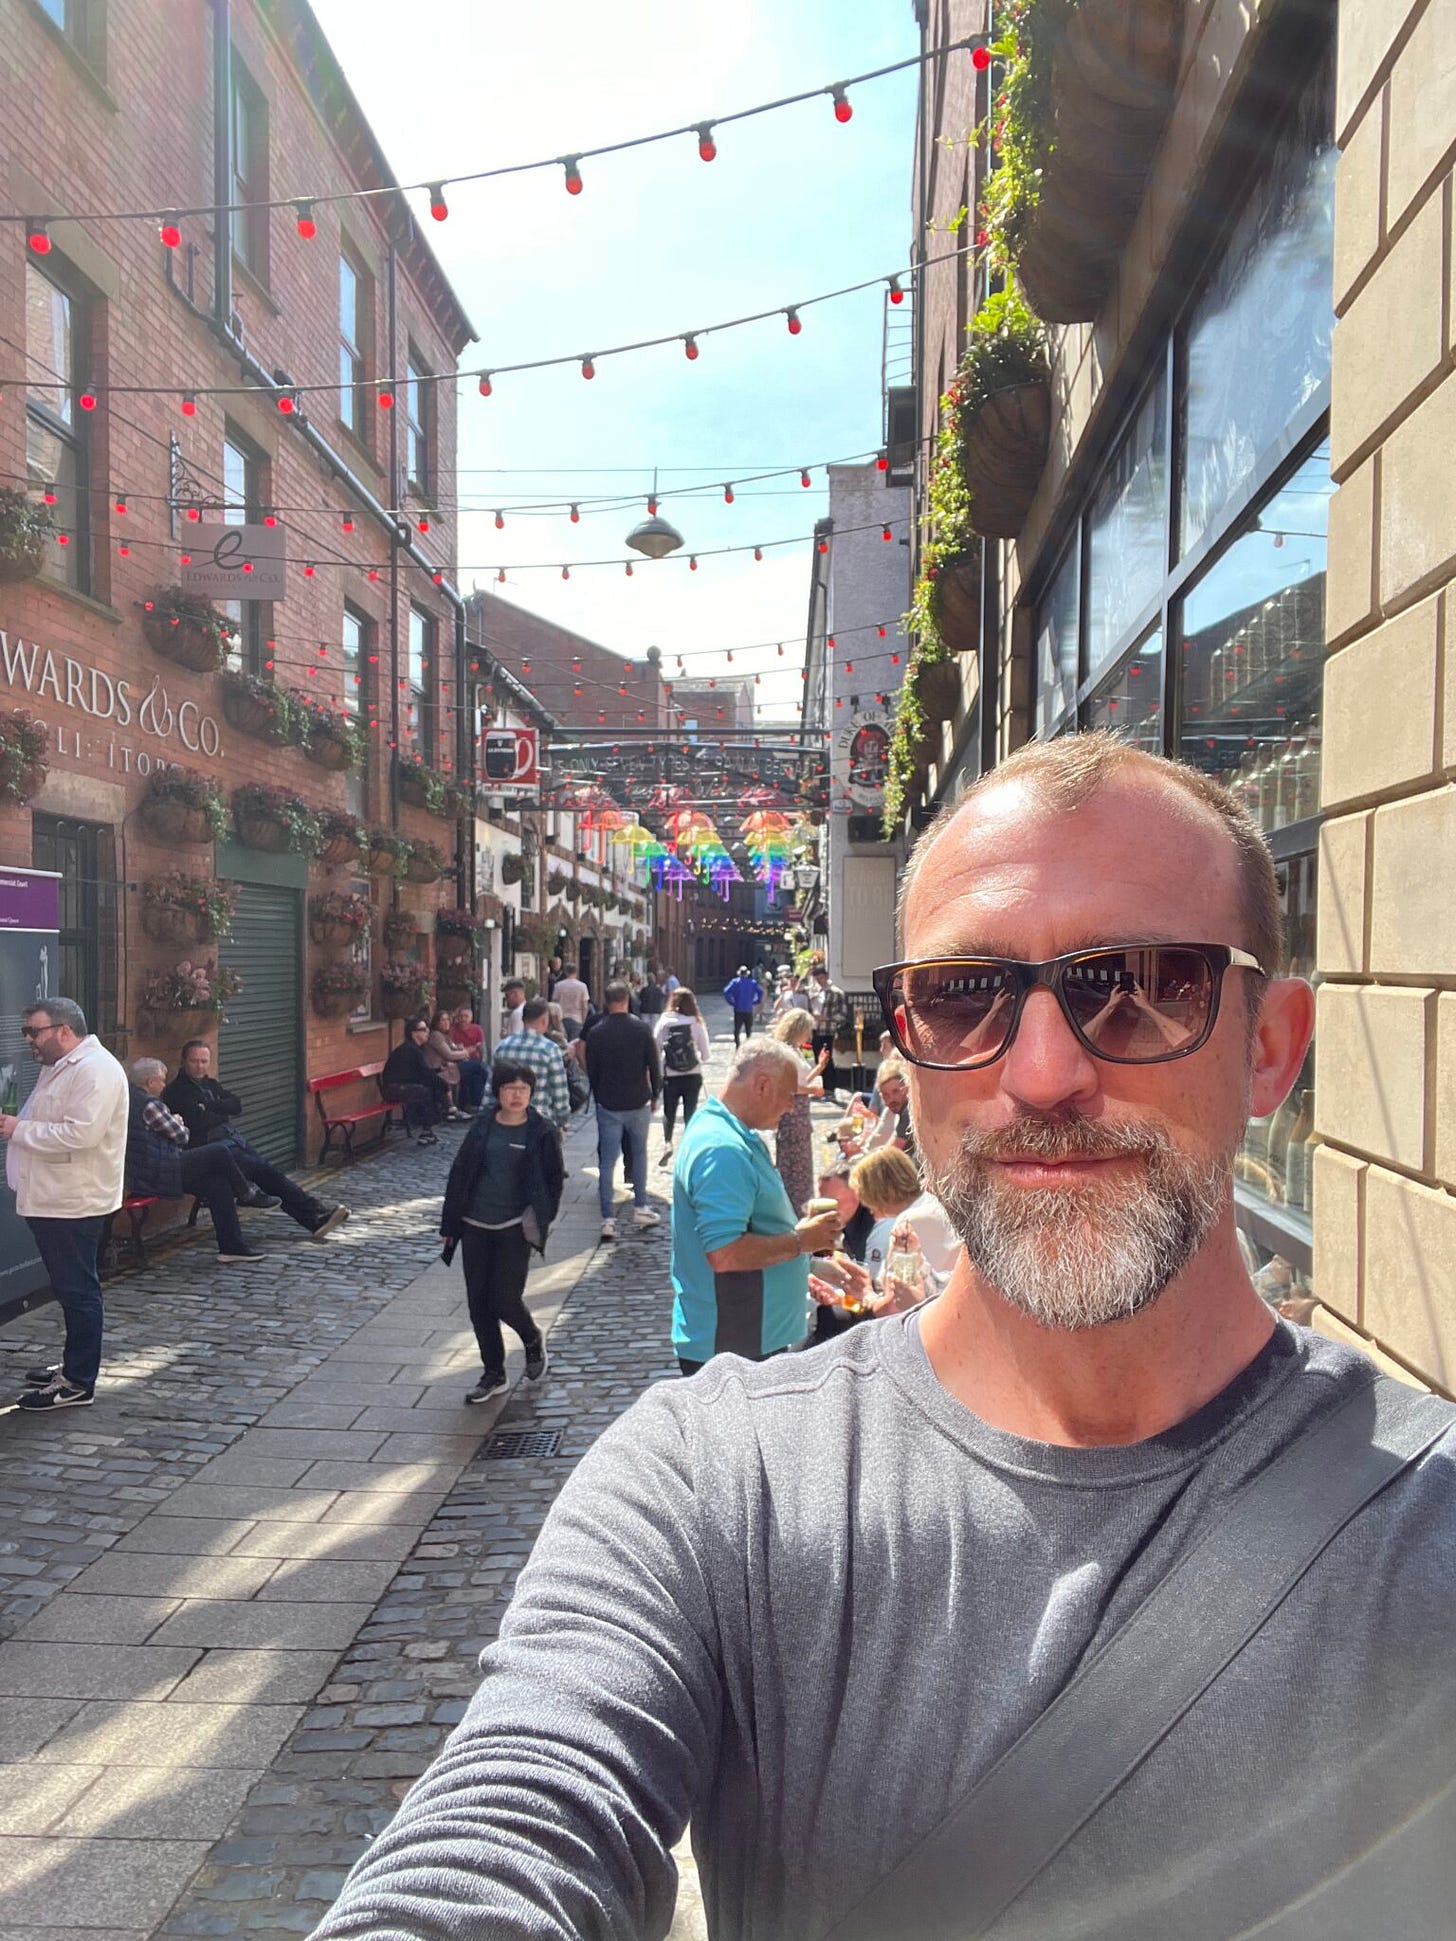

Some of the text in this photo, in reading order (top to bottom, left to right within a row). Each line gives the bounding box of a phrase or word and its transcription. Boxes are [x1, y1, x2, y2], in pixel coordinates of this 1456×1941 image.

[186, 571, 242, 583] EDWARDS
[0, 629, 130, 726] WARDS
[140, 675, 173, 737] &
